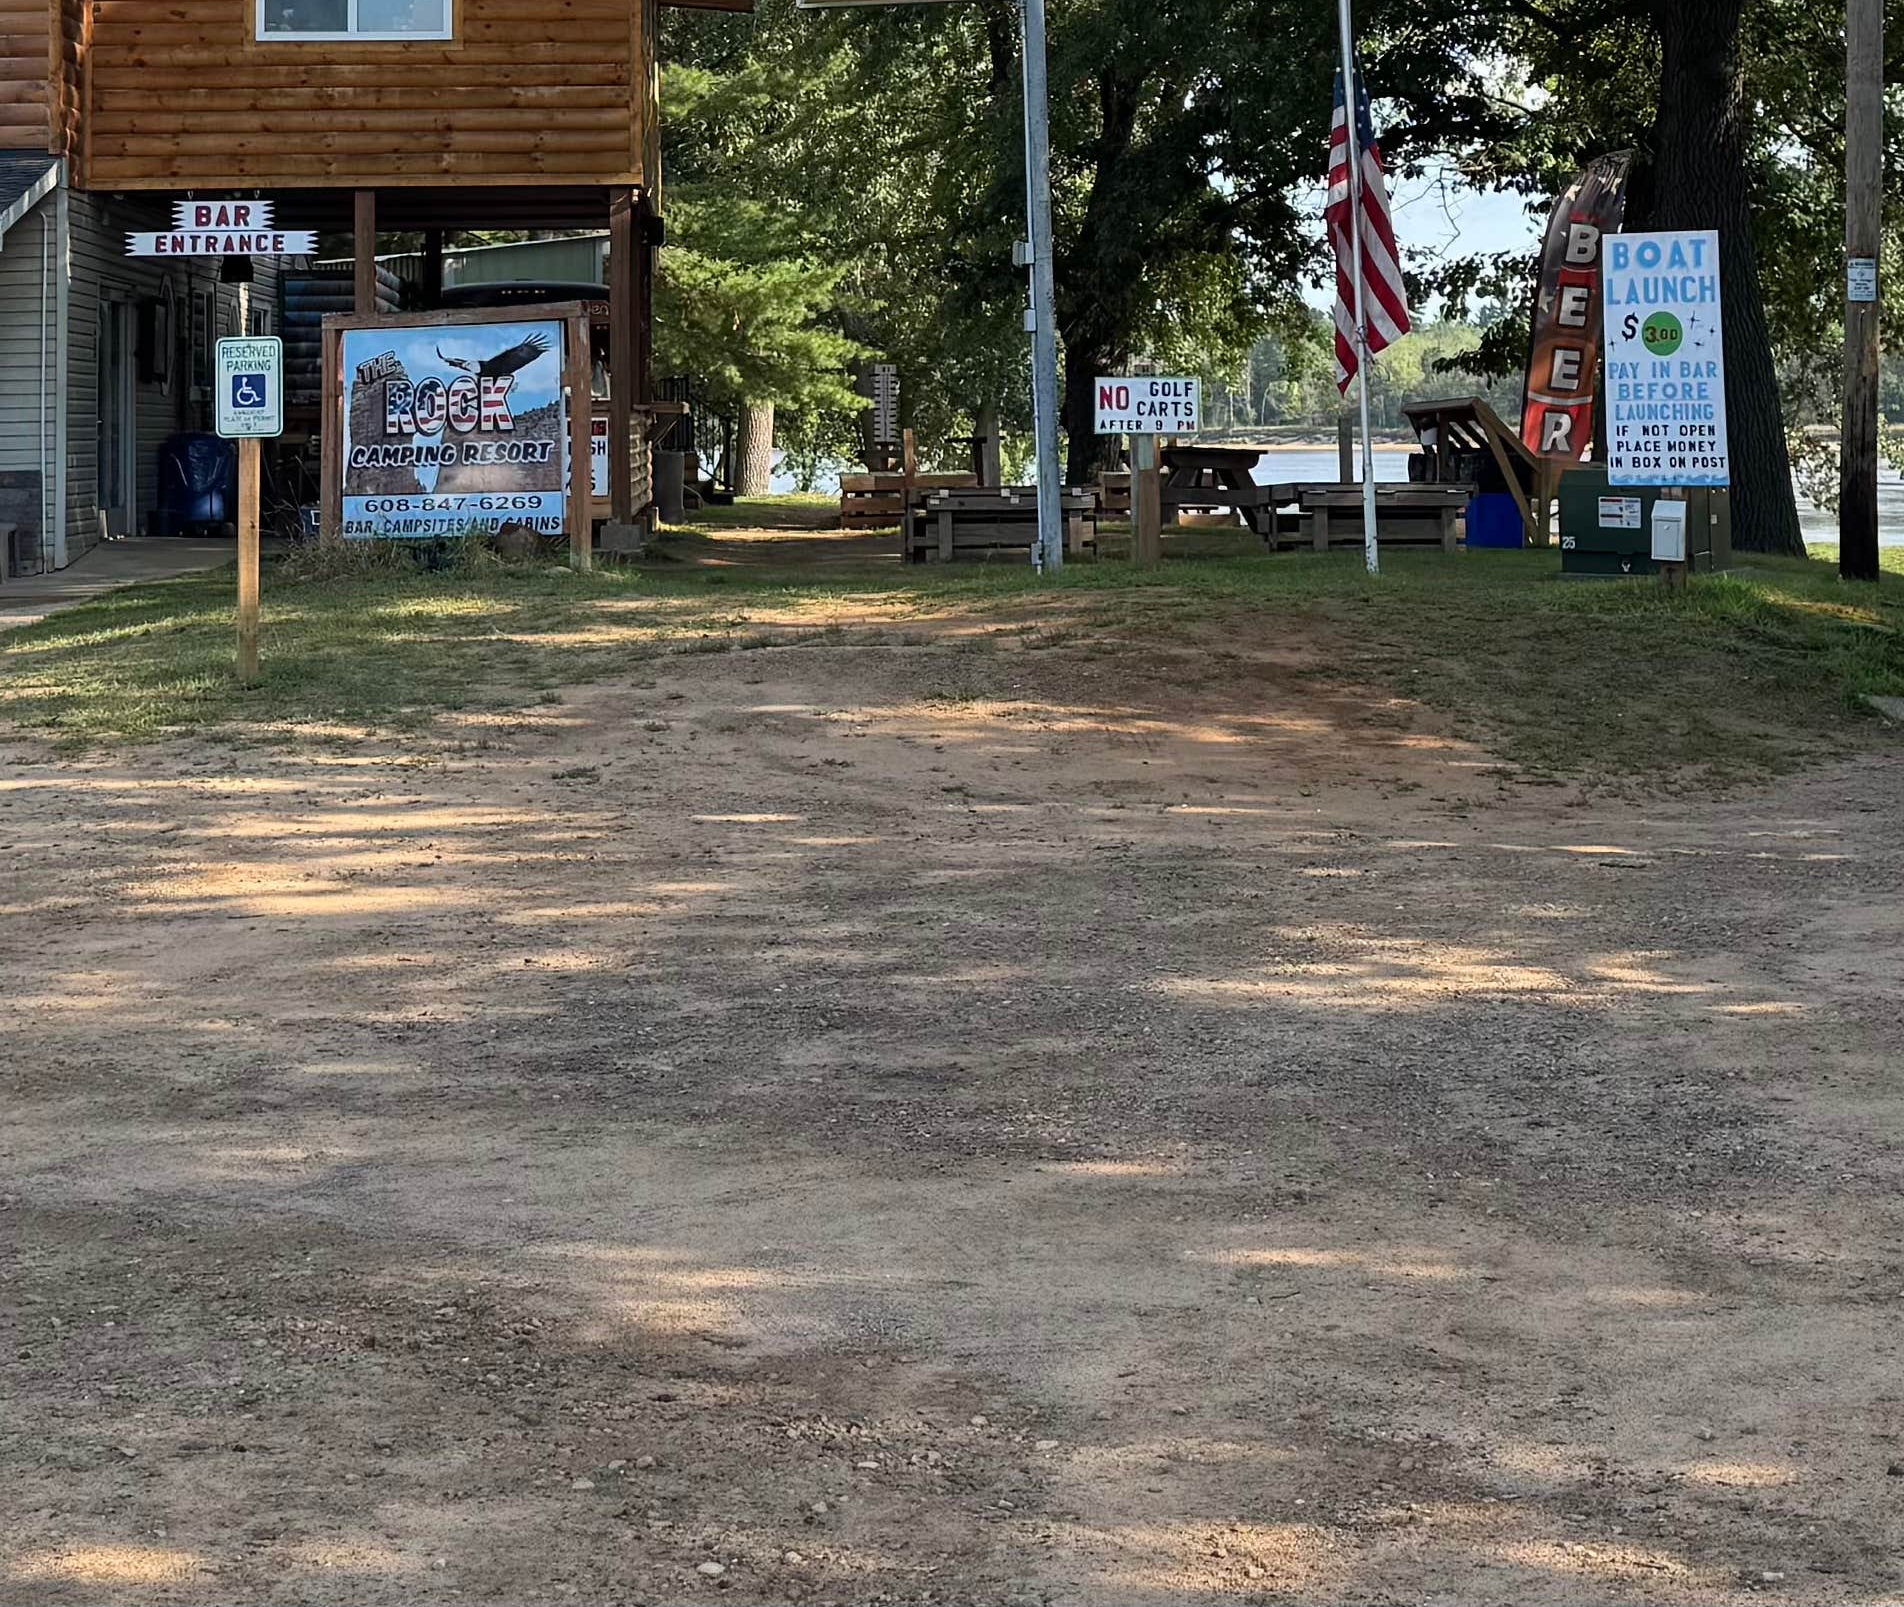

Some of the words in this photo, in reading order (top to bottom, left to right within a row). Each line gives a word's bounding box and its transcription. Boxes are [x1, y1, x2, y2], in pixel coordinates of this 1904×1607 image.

[195, 205, 251, 227] BAR
[155, 234, 285, 253] ENTRANCE
[1612, 239, 1707, 271] BOAT
[1606, 275, 1716, 305] LAUNCH
[1621, 311, 1639, 342] $
[1645, 325, 1679, 344] 3.00
[1541, 222, 1600, 453] BEER
[222, 345, 276, 359] RESERVED
[226, 360, 271, 372] PARKING
[357, 350, 397, 384] THE
[1608, 362, 1640, 379] PAY
[1652, 361, 1670, 378] IN
[1680, 361, 1718, 378] BAR
[1099, 385, 1129, 410] NO
[1149, 381, 1193, 397] GOLF
[1618, 383, 1708, 400] BEFORE
[384, 375, 516, 436] ROCK
[1137, 401, 1193, 416] CARTS
[1615, 403, 1714, 421] LAUNCHING
[1100, 419, 1143, 430] AFTER
[1155, 420, 1163, 430] 9
[1177, 420, 1195, 430] PM
[1616, 425, 1629, 436] IF
[1642, 425, 1669, 436] NOT
[1680, 425, 1715, 436] OPEN
[351, 444, 457, 468] CAMPING
[462, 440, 555, 465] RESORT
[1617, 441, 1661, 452] PLACE
[1668, 441, 1716, 452] MONEY
[1610, 457, 1623, 468] IN
[1632, 457, 1661, 468] BOX
[1669, 457, 1686, 468] ON
[1692, 457, 1726, 468] POST
[365, 496, 542, 513] 608-847-6269
[384, 518, 464, 533] CAMPSITES
[1562, 536, 1576, 549] 25
